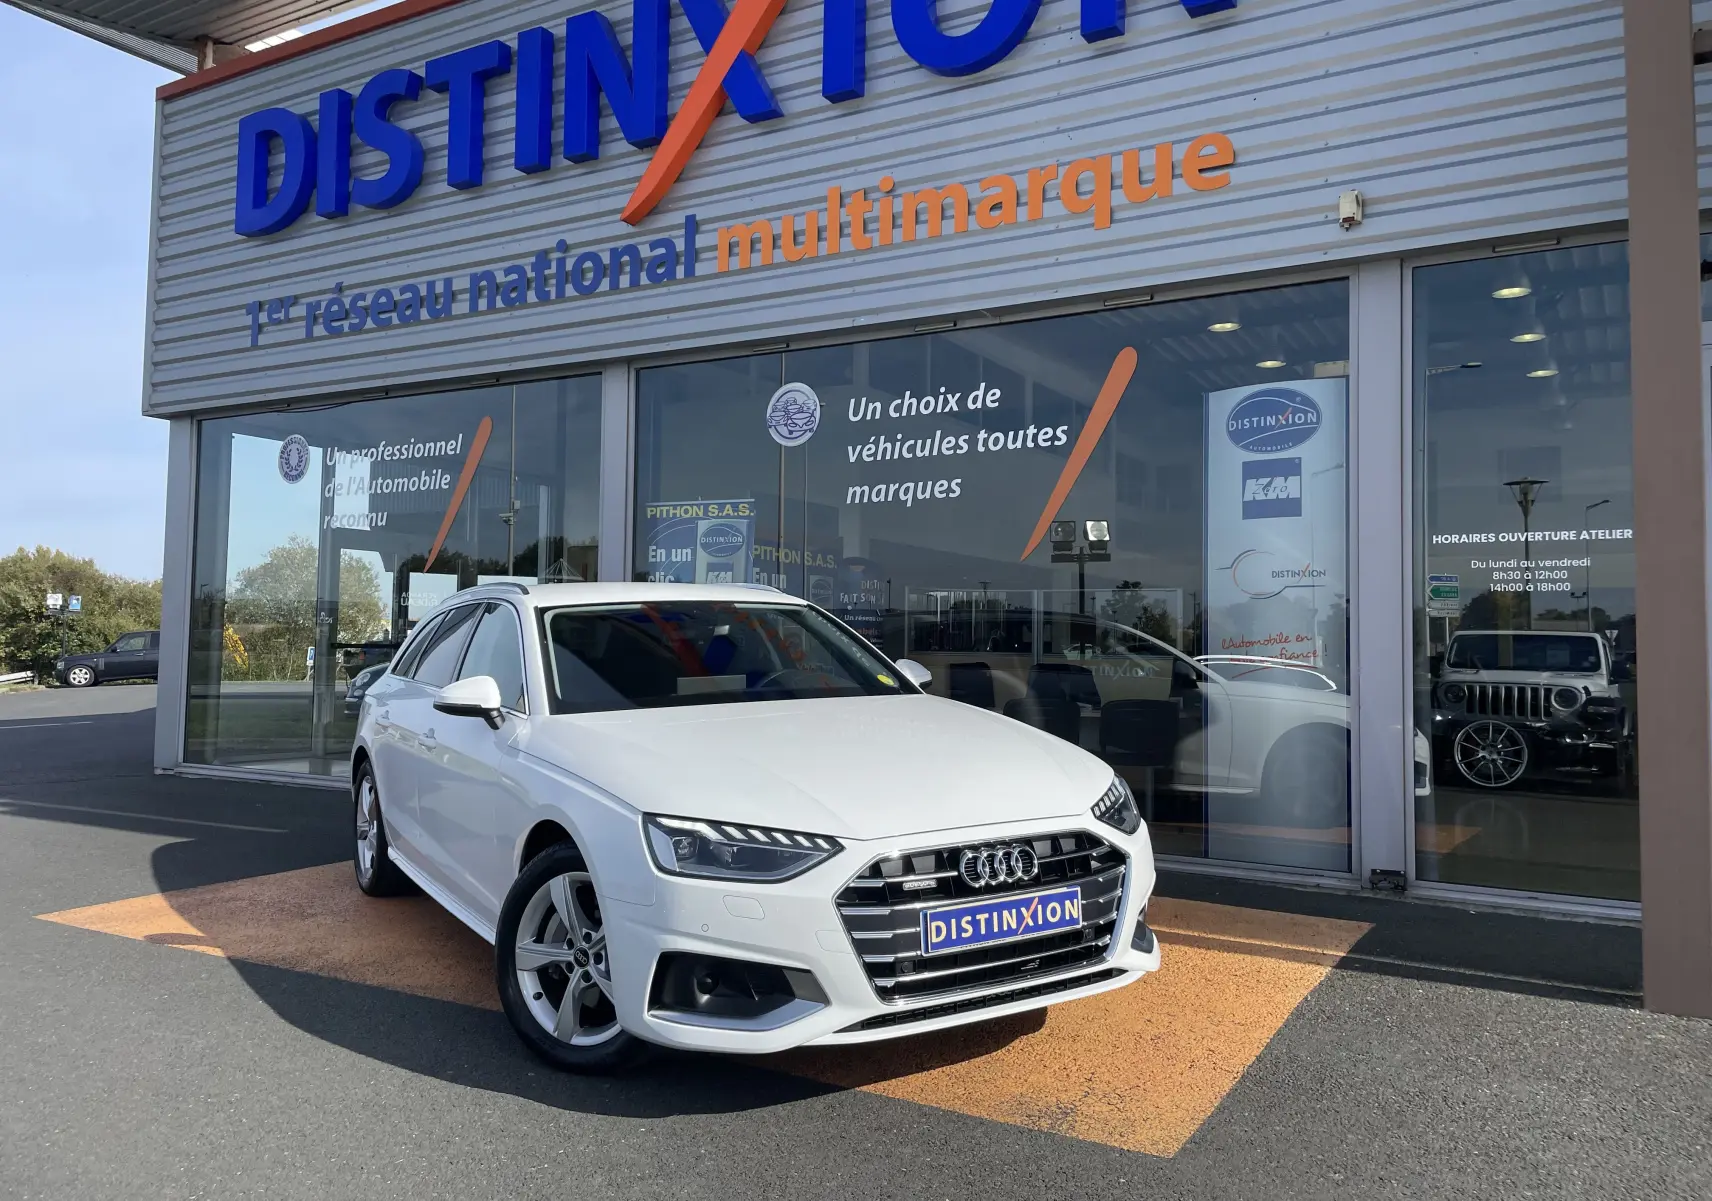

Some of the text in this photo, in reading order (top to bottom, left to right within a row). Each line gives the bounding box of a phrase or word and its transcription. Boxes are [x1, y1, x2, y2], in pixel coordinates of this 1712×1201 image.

[235, 0, 1236, 238] DISTINXI
[246, 131, 1235, 347] 1er réseau national multimarque
[848, 382, 1001, 422] Un choix de
[1229, 407, 1317, 431] DISTINXION
[326, 433, 463, 469] Un professionnel
[847, 424, 1068, 463] véhicules toutes
[325, 469, 451, 498] de l'Automobile
[846, 478, 962, 507] marques
[323, 511, 388, 530] reconnu
[647, 503, 755, 519] PITHON S.A.S.
[701, 534, 743, 544] DISTINXION
[1433, 529, 1633, 545] HORAIRES OUVERTURE ATELIER
[648, 546, 666, 562] En
[672, 547, 692, 562] un
[752, 545, 801, 565] PITHON
[1471, 560, 1487, 569] Du
[1489, 559, 1517, 568] lundi
[1538, 558, 1591, 567] vendredi
[752, 567, 787, 589] En un
[1272, 563, 1326, 582] DISTINXION
[1492, 570, 1568, 580] 8h30 à 12h00
[1489, 582, 1571, 592] 14h00 à 18h00
[1296, 634, 1312, 643] en
[931, 896, 1079, 944] DISTINXION
